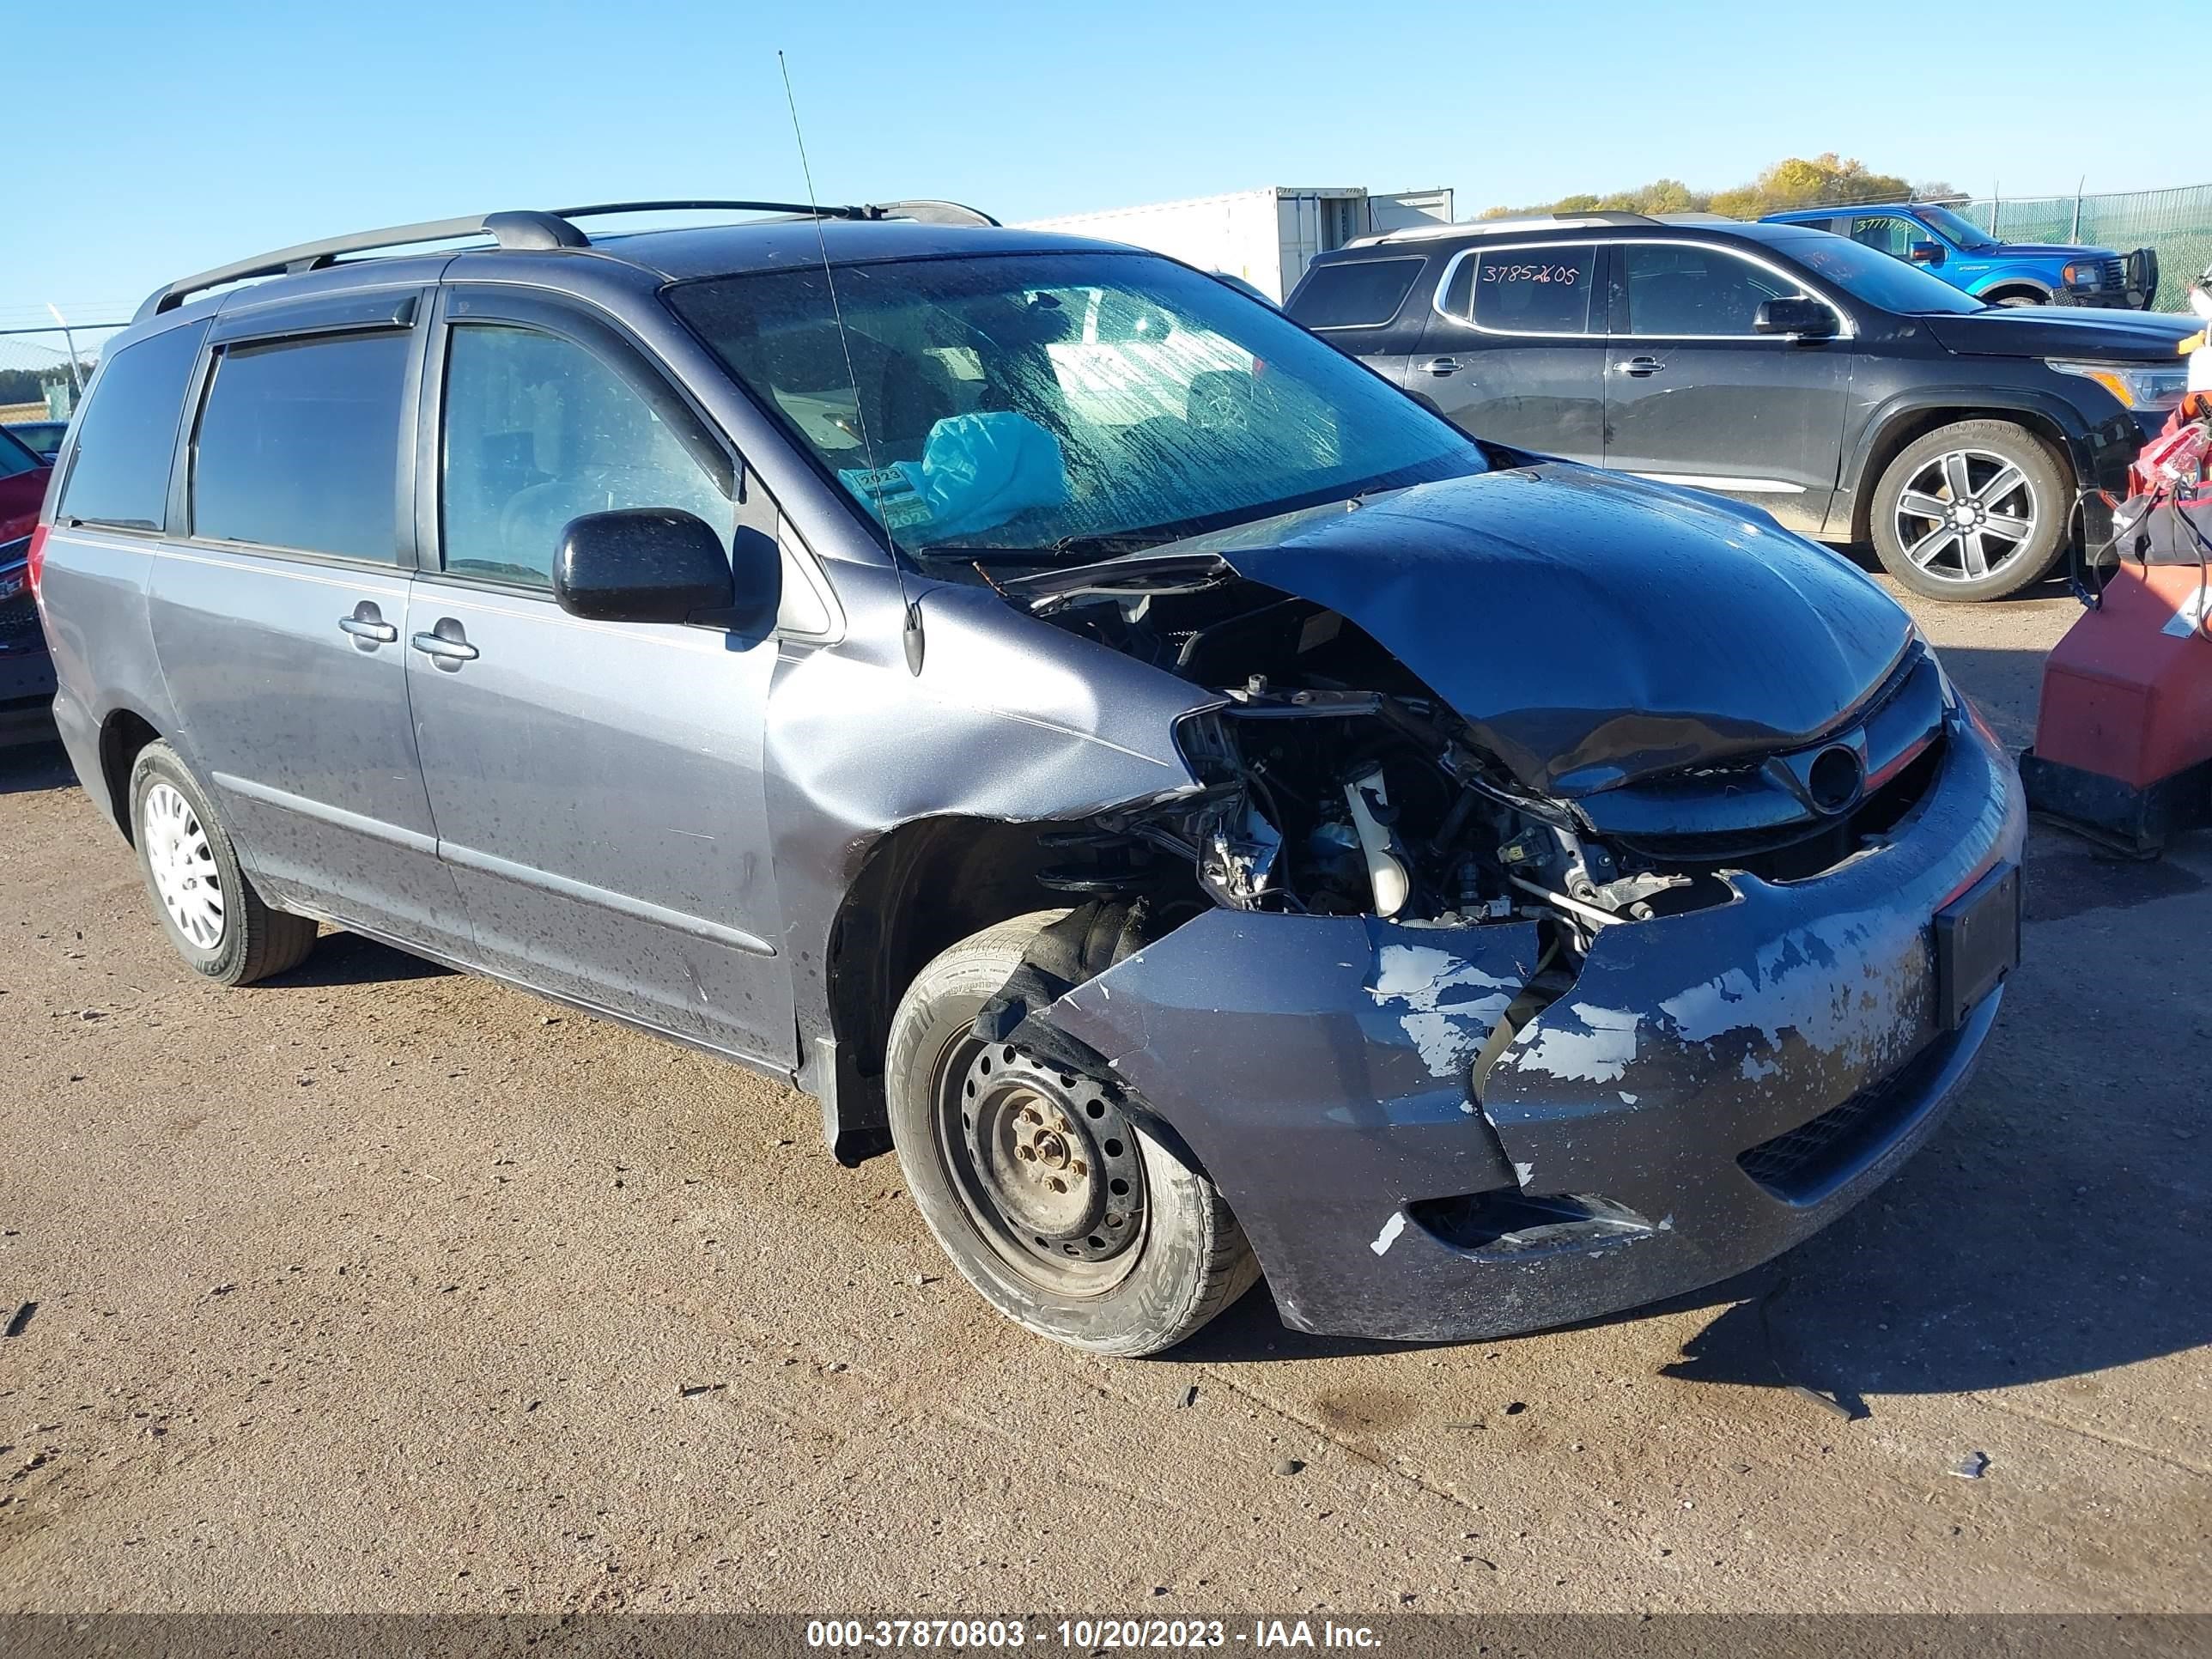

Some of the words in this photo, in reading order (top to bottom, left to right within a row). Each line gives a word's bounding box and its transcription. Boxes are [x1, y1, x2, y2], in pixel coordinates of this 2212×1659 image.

[1482, 264, 1580, 285] 37852605
[860, 471, 901, 484] 2023
[890, 510, 933, 529] 2021
